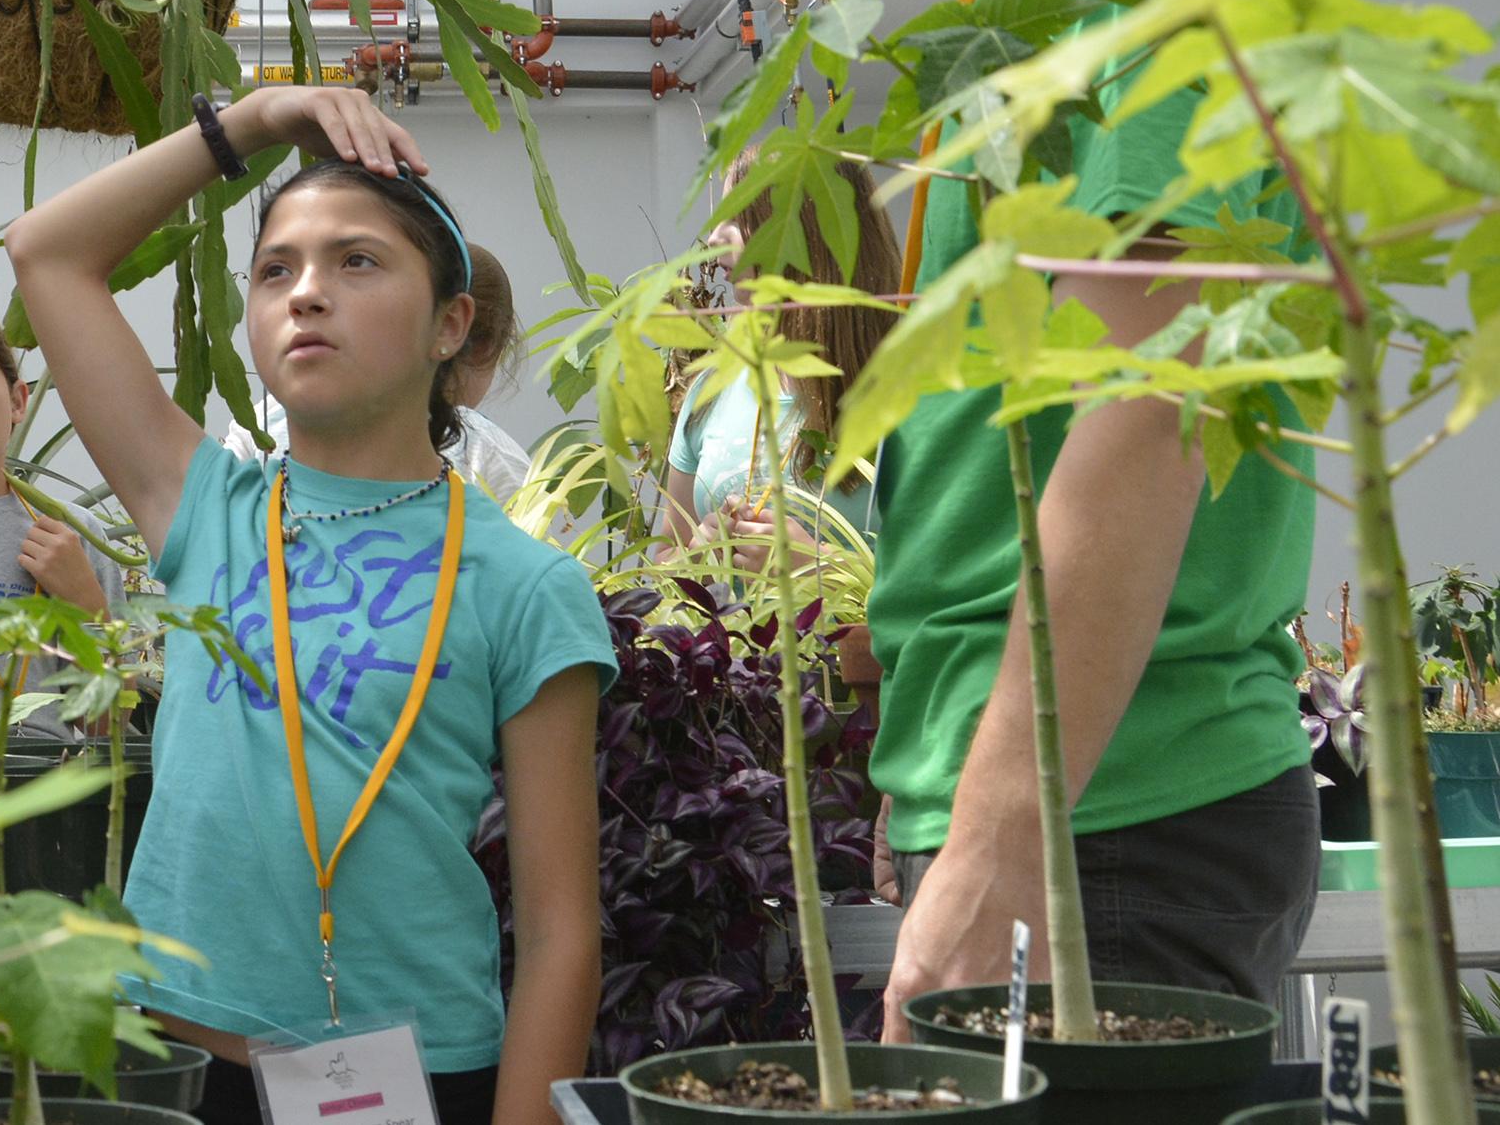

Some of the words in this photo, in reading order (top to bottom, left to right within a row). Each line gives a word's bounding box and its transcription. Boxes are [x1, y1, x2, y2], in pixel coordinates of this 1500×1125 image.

[261, 66, 275, 80] OT
[279, 66, 309, 80] WAR
[318, 66, 348, 80] ETURN
